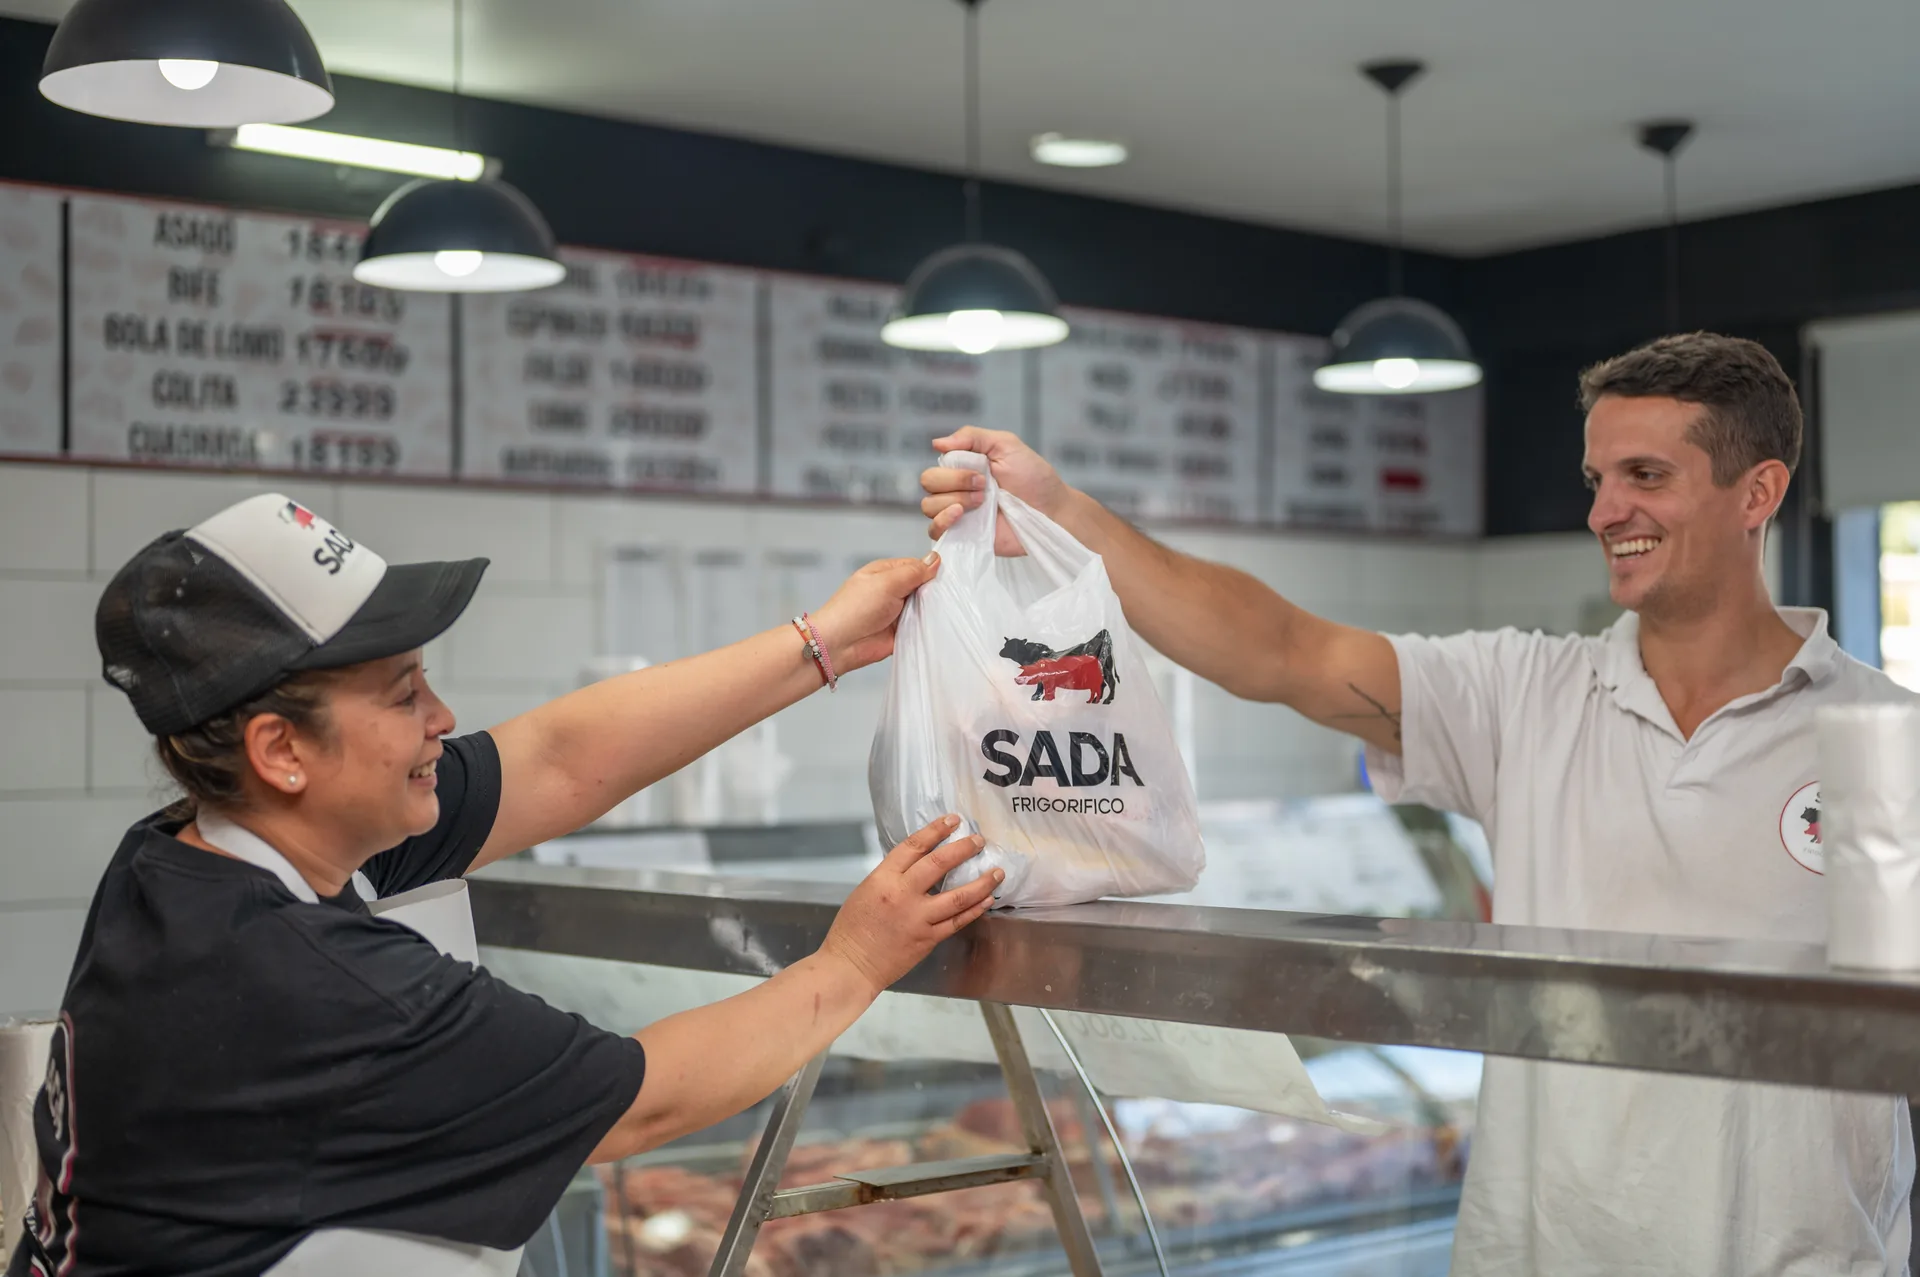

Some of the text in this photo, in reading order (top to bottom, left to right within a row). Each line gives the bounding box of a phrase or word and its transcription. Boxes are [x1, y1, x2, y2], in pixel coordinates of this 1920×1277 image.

[154, 213, 236, 255] ASADO
[168, 265, 220, 308] BIFE
[103, 311, 169, 352] BOLA
[175, 317, 208, 358] DE
[213, 321, 285, 365] LOMO
[152, 368, 239, 412] COLITA
[313, 528, 354, 575] SAD
[981, 728, 1145, 788] SADA
[1011, 796, 1125, 815] FRIGORIFICO
